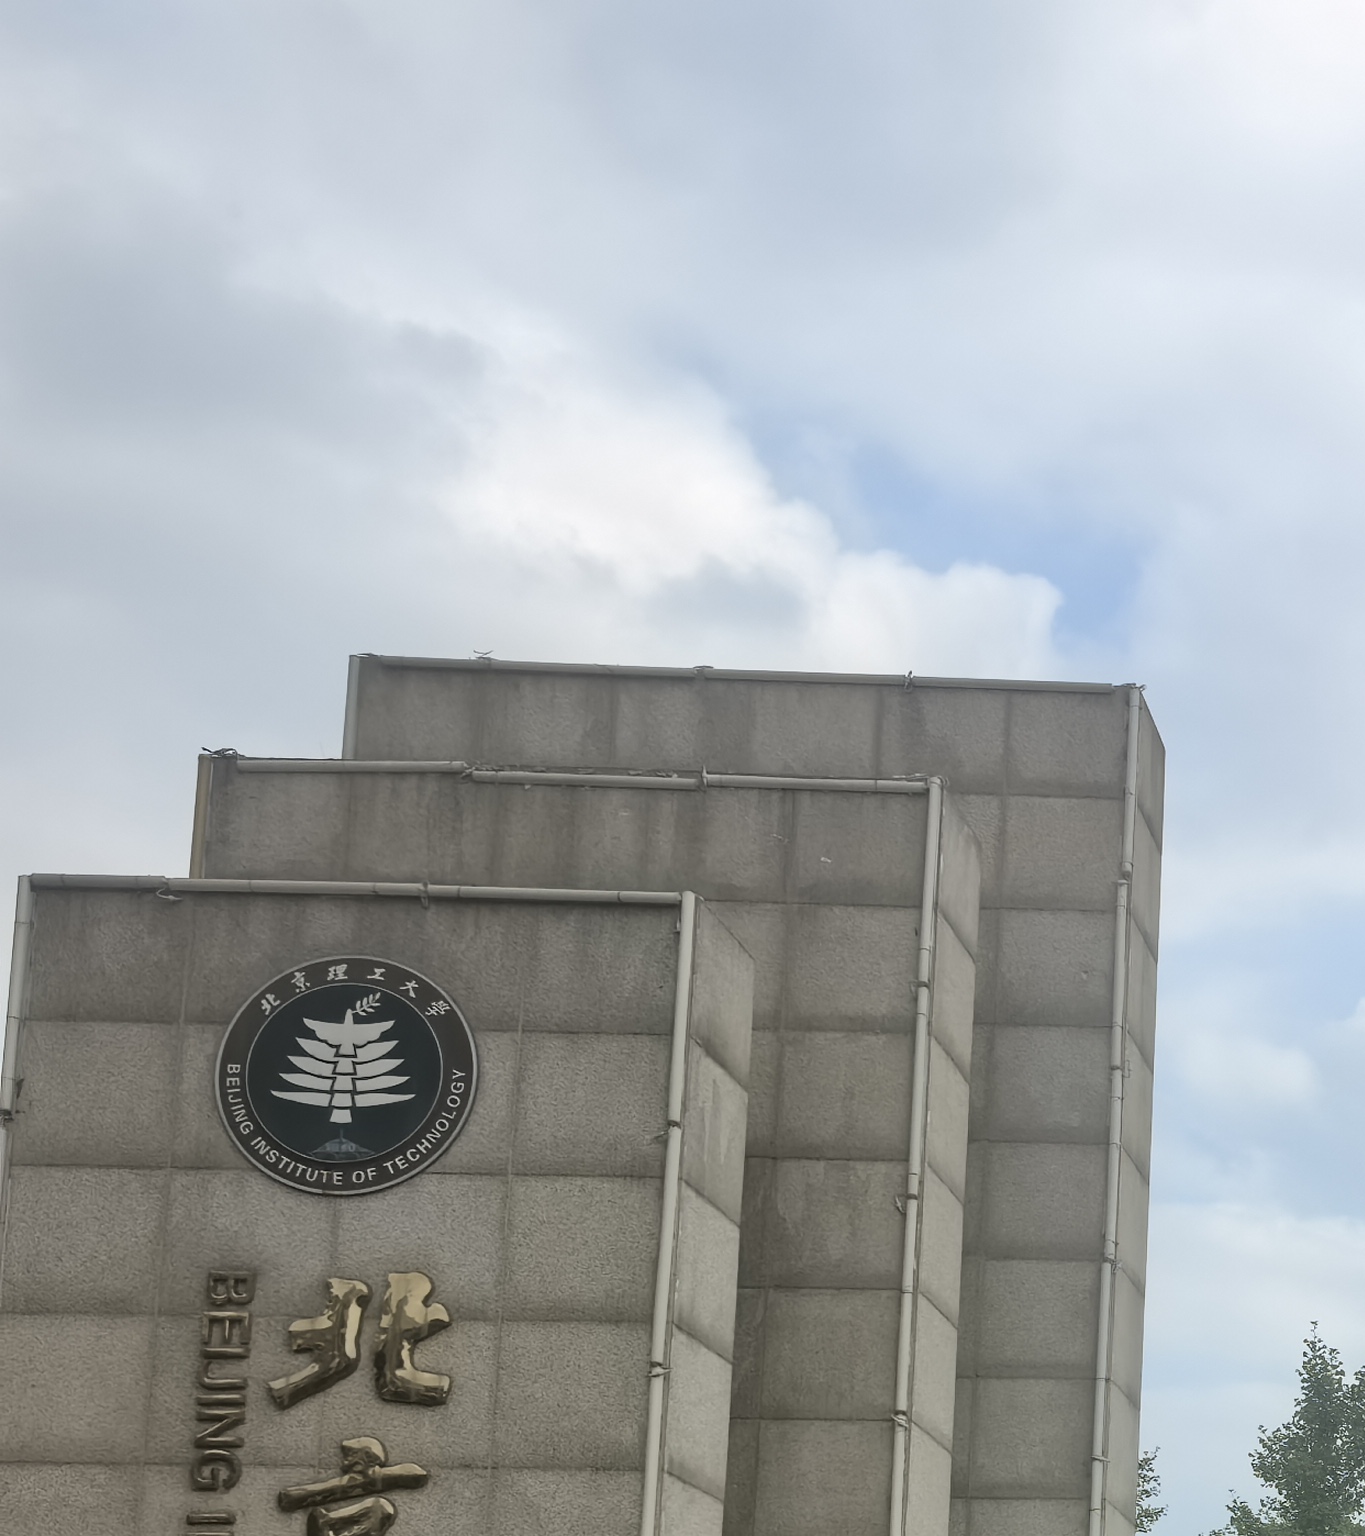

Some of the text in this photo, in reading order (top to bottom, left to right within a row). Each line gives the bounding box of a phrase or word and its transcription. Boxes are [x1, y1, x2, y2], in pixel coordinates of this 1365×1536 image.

[226, 1063, 466, 1185] BEIJING INSTITUTE OF TECHNOLOGY
[190, 1269, 257, 1493] BEIJING
